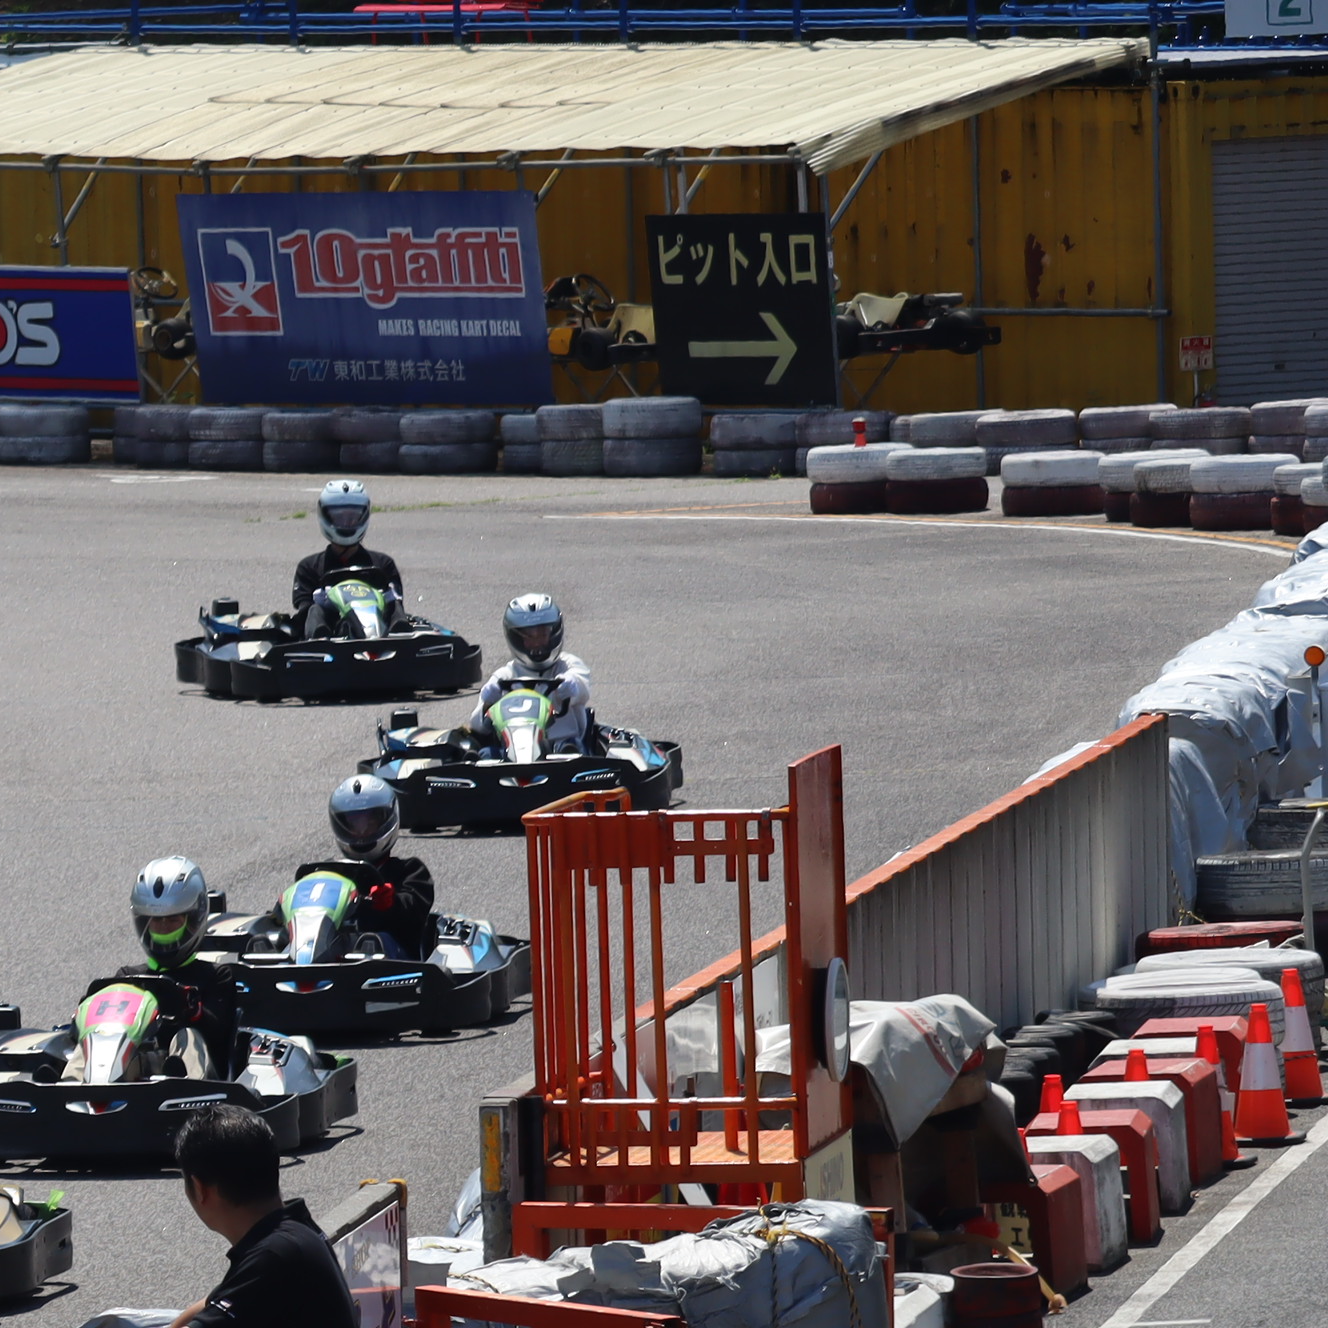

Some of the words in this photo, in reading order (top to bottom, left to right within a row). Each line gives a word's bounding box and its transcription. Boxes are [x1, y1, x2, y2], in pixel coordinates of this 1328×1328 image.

[657, 232, 817, 287] ピット入口
[378, 319, 414, 336] MAKES
[418, 319, 459, 337] RACING
[461, 319, 488, 337] KART
[490, 320, 521, 337] DECAL
[333, 359, 466, 382] 東和工業株式会社
[508, 699, 533, 713] J
[95, 1000, 130, 1016] H
